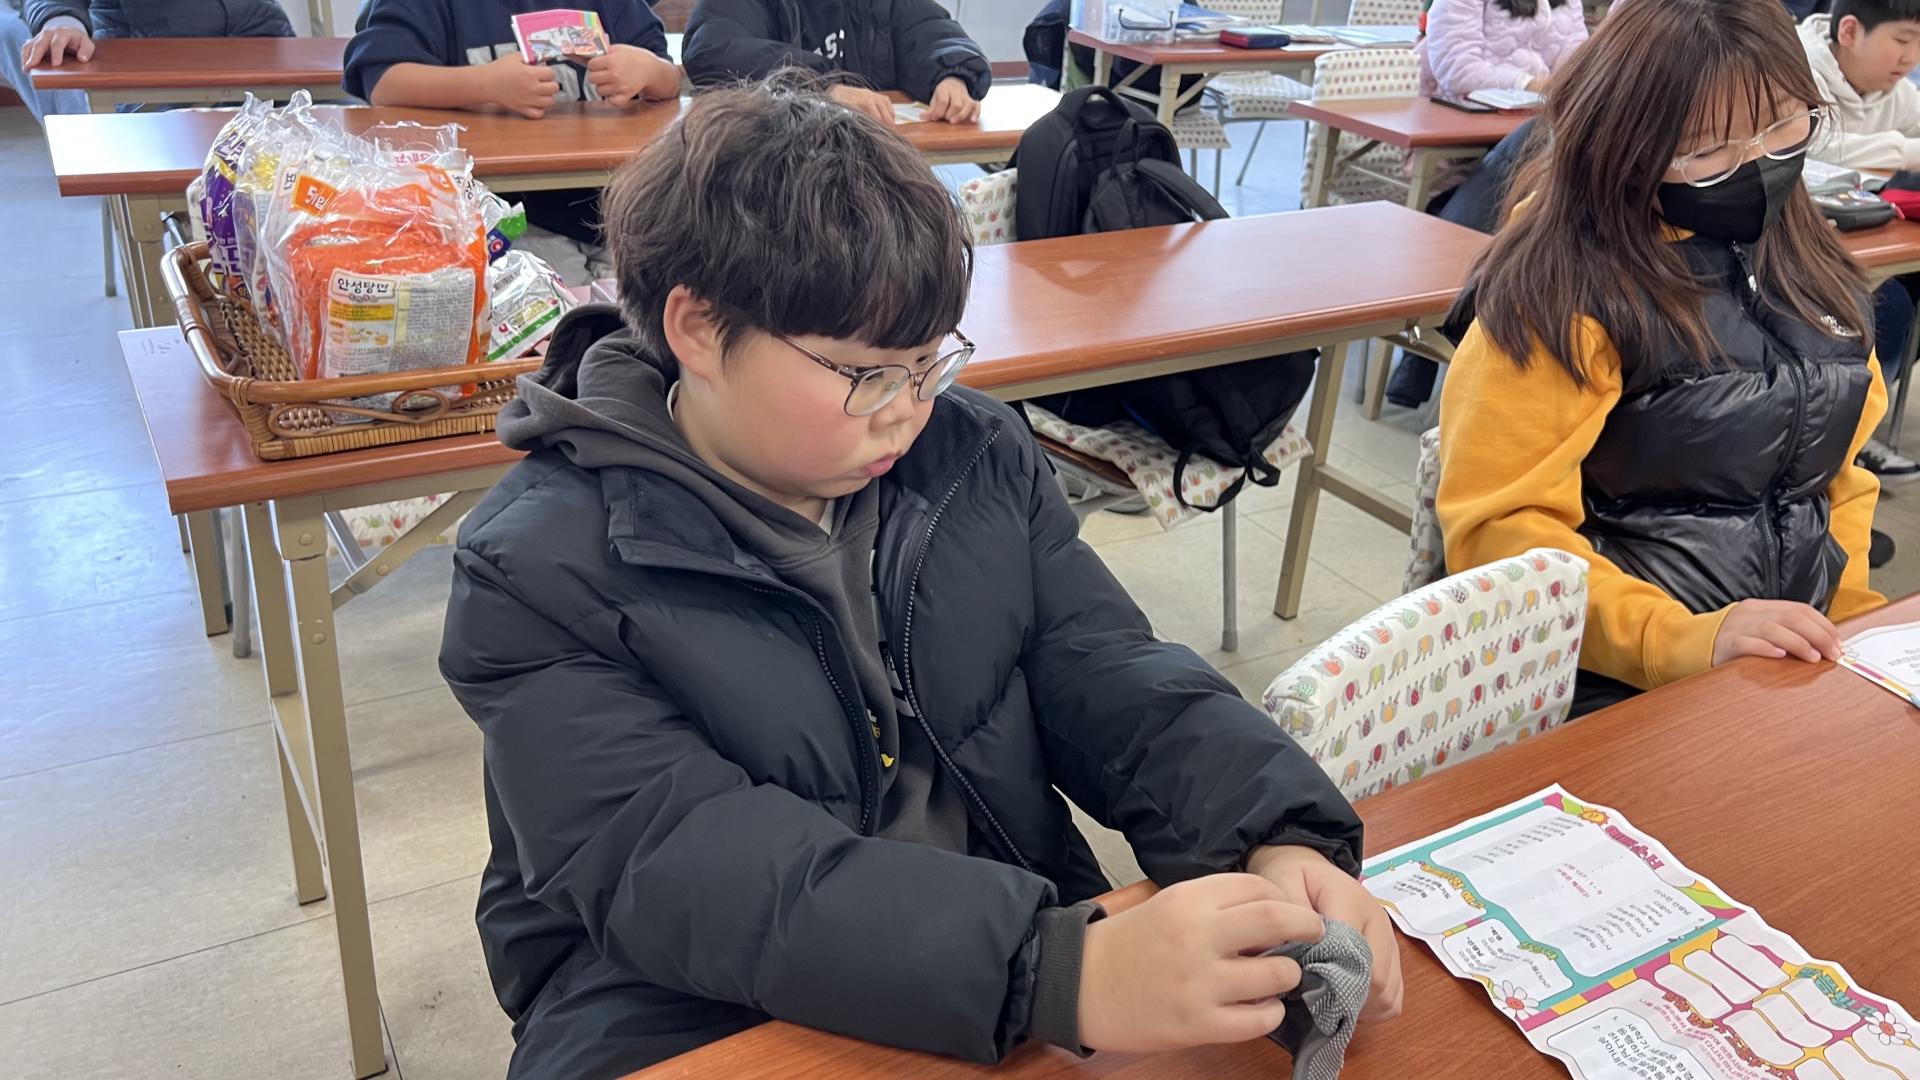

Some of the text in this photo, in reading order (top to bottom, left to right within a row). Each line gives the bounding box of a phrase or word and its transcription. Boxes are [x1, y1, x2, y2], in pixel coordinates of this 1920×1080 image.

[337, 278, 389, 294] 안성탕면
[1598, 1036, 1627, 1067] 살아내는
[1608, 1032, 1639, 1062] 하나님의
[1617, 1028, 1675, 1075] 동행하는 초등부
[1625, 1024, 1650, 1049] 새학기
[1650, 1048, 1677, 1062] 새로운
